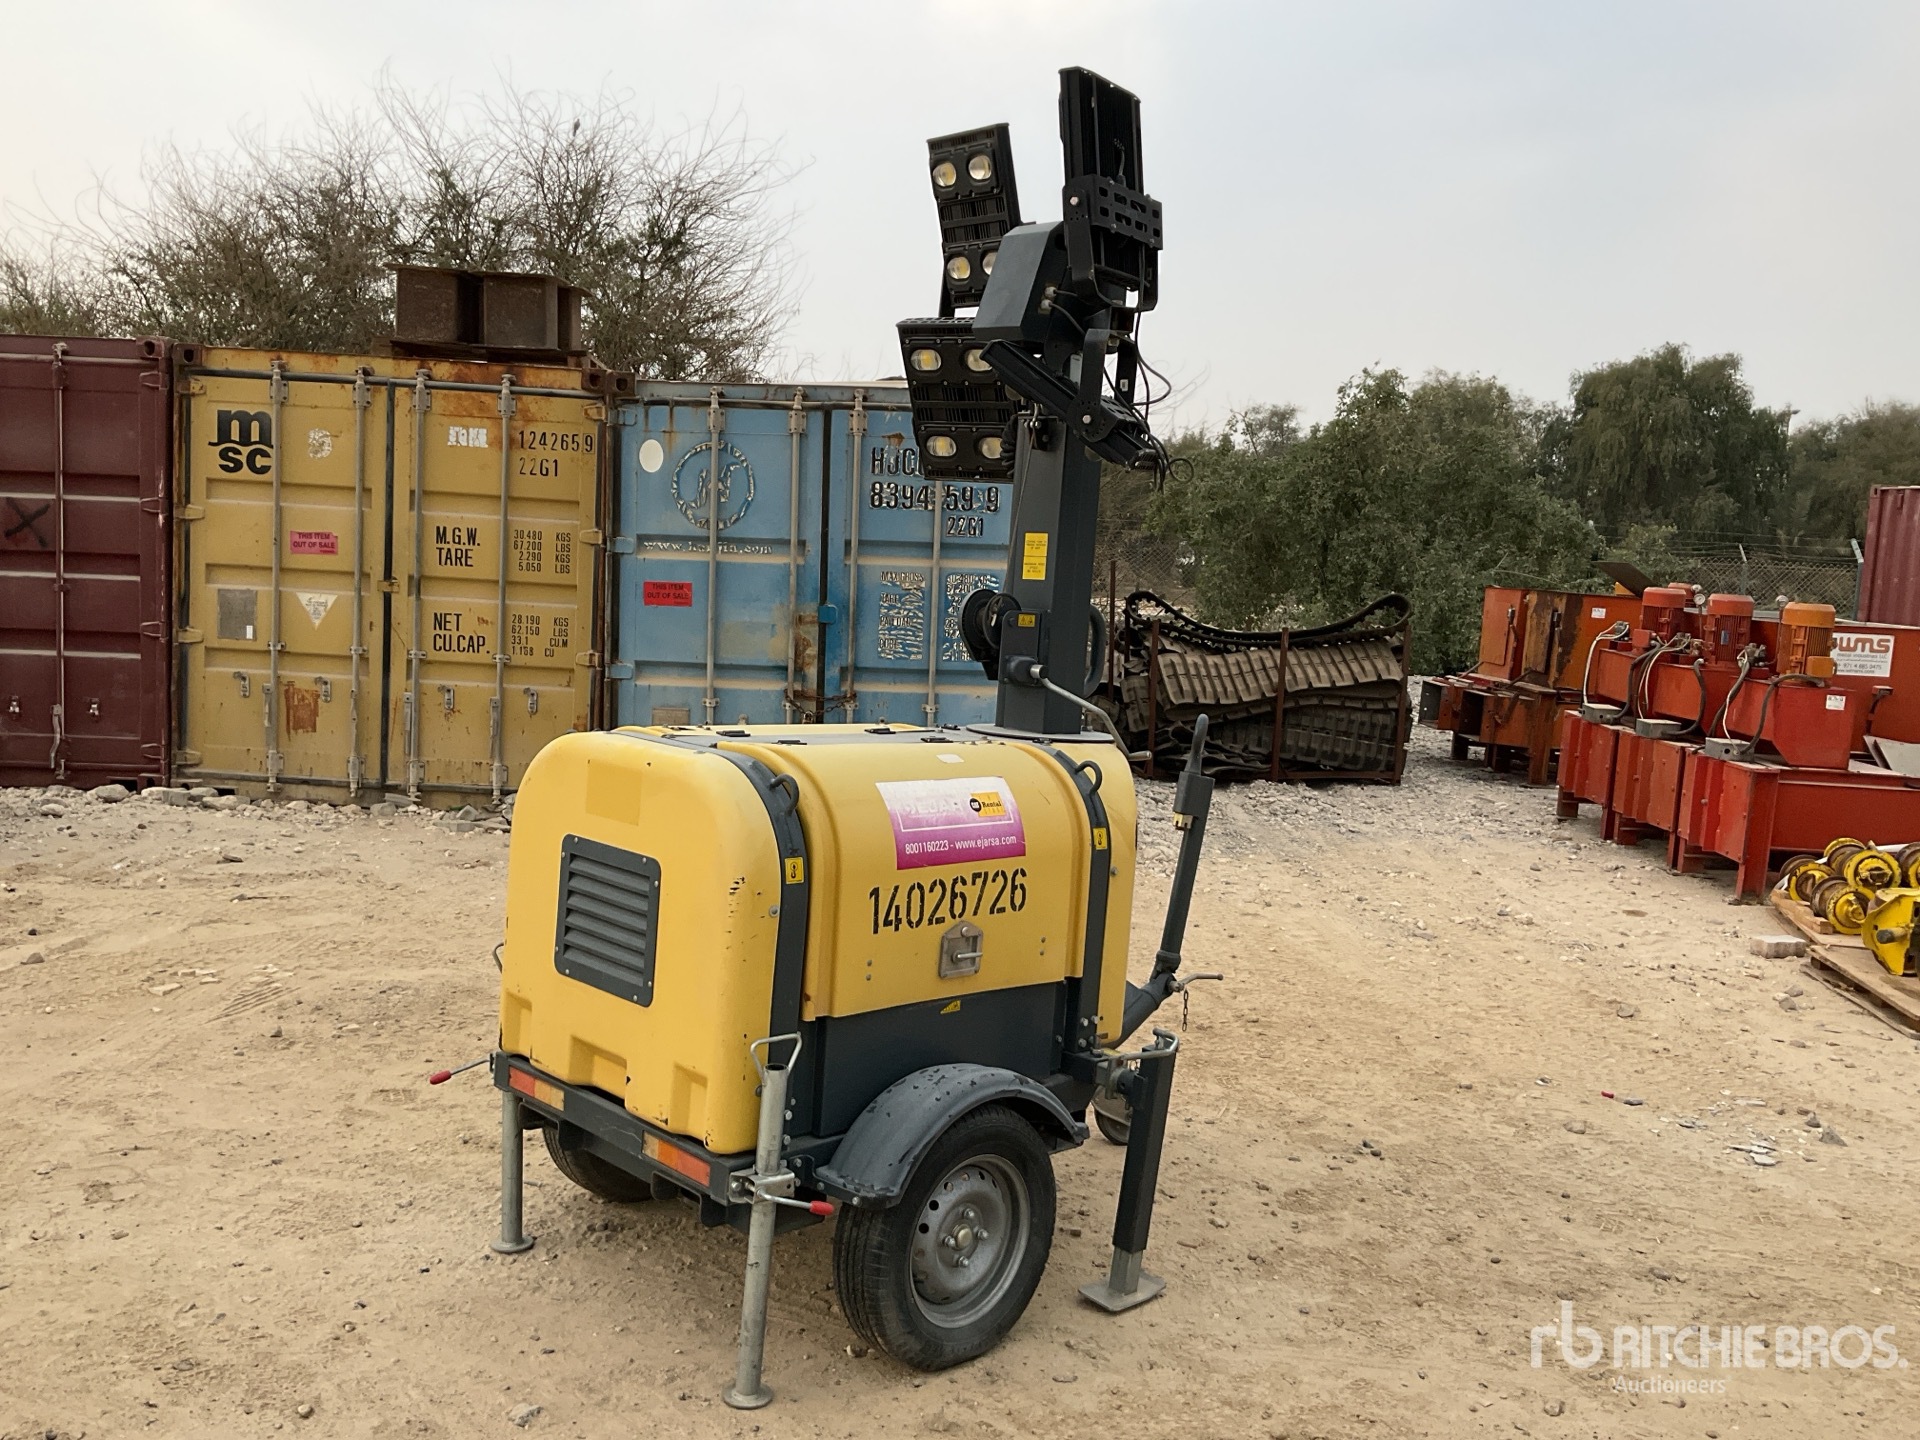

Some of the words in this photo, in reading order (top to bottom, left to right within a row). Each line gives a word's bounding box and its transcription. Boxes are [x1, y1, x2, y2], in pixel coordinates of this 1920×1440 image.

[519, 457, 558, 476] 22G1
[871, 447, 925, 476] HJC
[297, 532, 313, 540] THIS
[314, 532, 330, 540] ITEM
[435, 525, 481, 546] M.G.W.
[513, 529, 543, 541] 30.480
[555, 532, 571, 543] KGS
[946, 516, 984, 536] 22G1
[436, 547, 474, 567] TARE
[555, 553, 571, 564] KGS
[555, 543, 571, 553] LBS
[554, 563, 571, 574] LBS
[433, 612, 462, 632] NET
[553, 617, 569, 627] KGS
[553, 627, 569, 637] LBS
[981, 800, 1002, 808] Rental
[905, 840, 949, 855] 8001160223
[954, 835, 1017, 850] www.ejarsa.com
[869, 867, 1028, 935] 14026726
